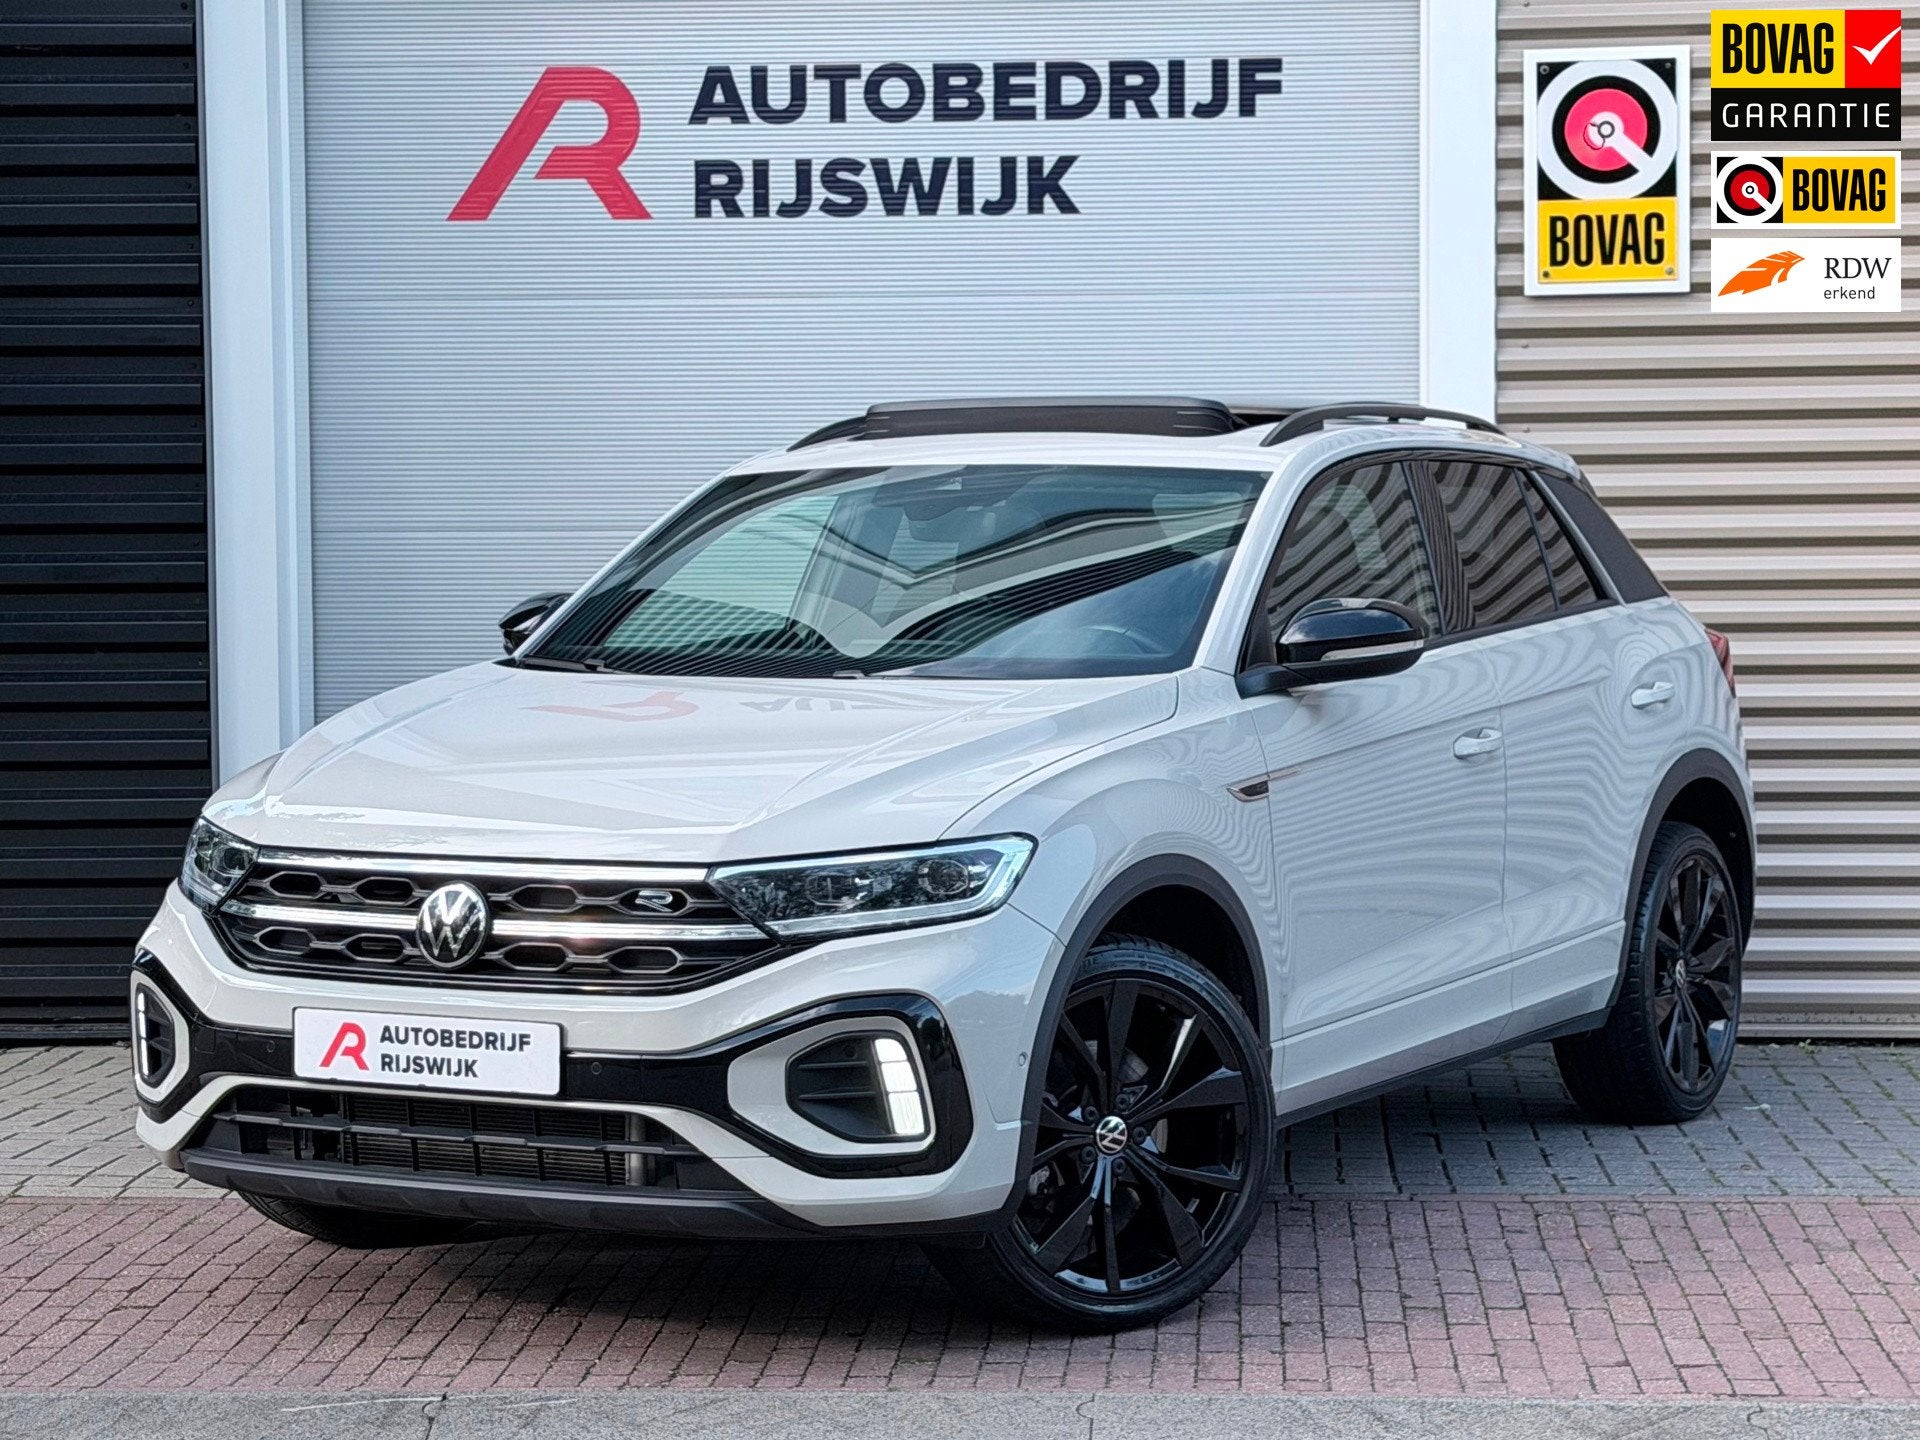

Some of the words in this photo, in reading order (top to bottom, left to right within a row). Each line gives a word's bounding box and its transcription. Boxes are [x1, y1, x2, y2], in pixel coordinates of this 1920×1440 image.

[689, 58, 1284, 124] AUTOBEDRIJF
[693, 155, 1081, 218] RIJSWIJK
[1549, 212, 1665, 267] BOVAG
[635, 890, 673, 912] R
[379, 1025, 531, 1052] AUTOBEDRIJF
[380, 1053, 479, 1078] RIJSWIJK
